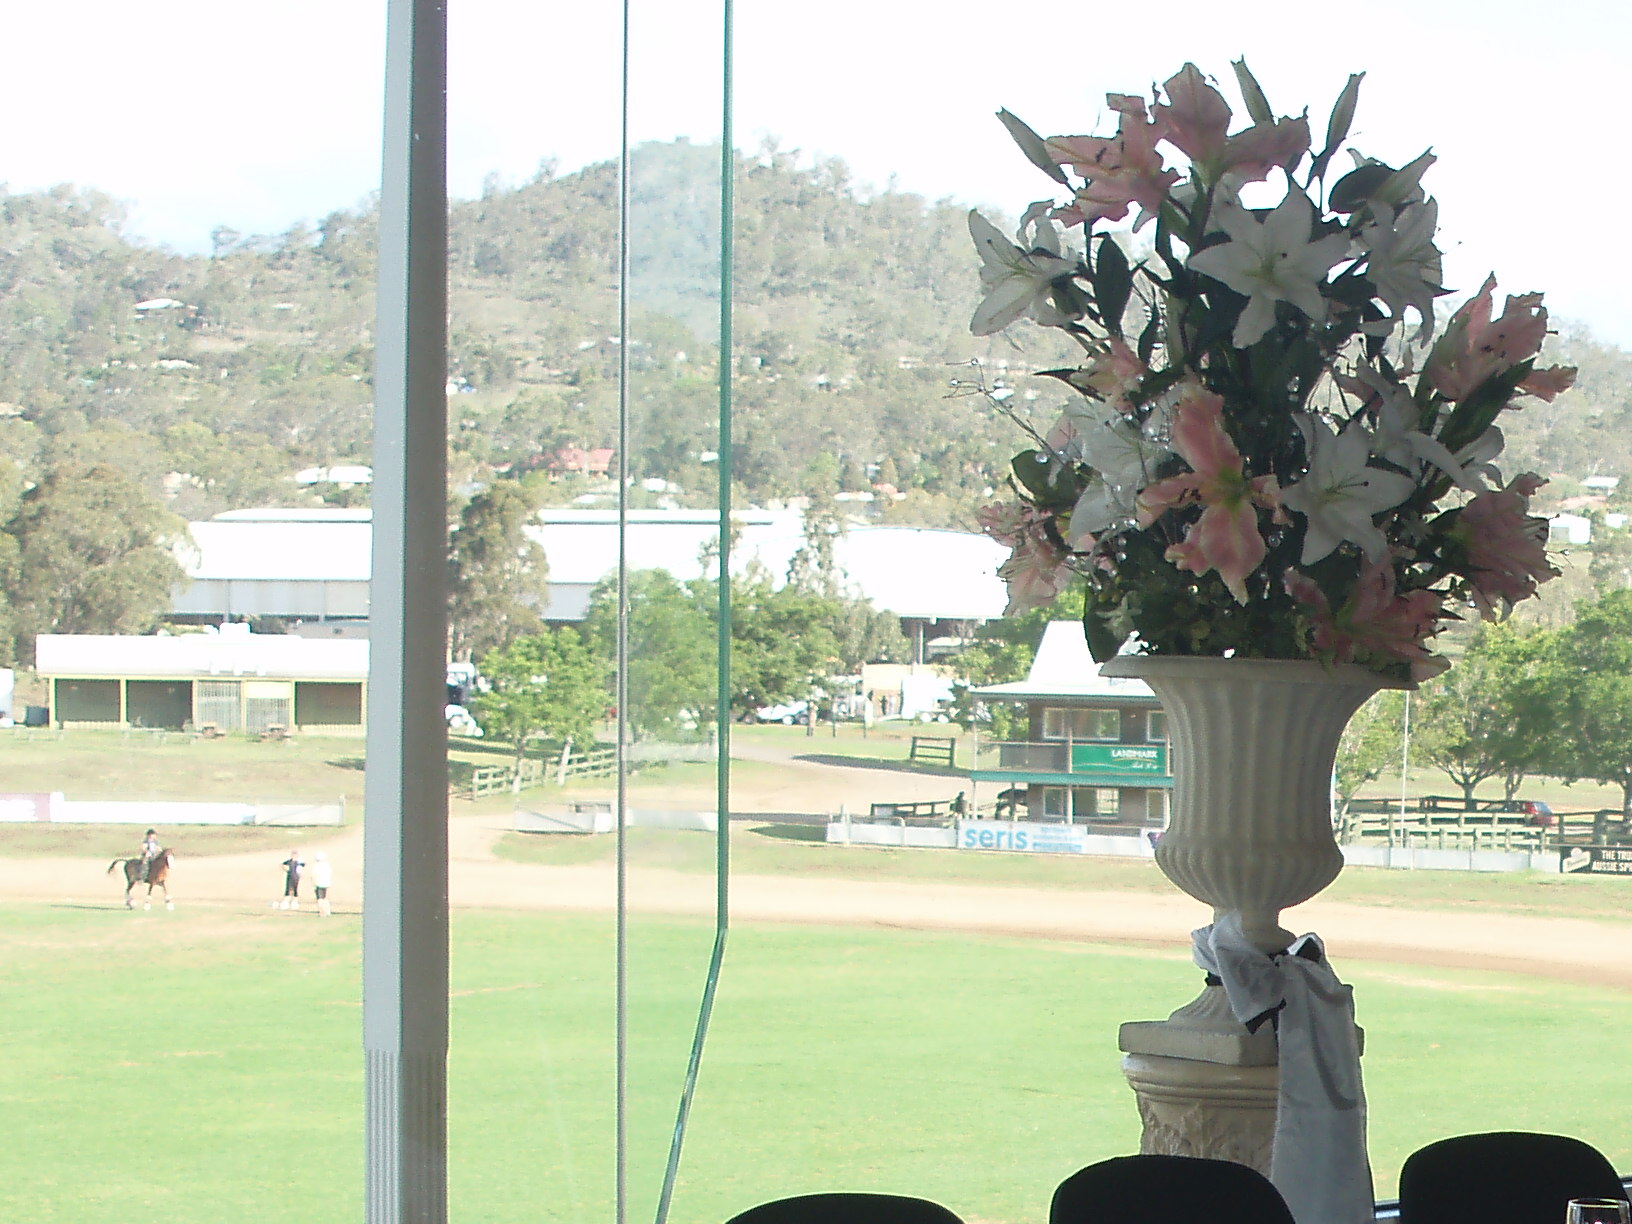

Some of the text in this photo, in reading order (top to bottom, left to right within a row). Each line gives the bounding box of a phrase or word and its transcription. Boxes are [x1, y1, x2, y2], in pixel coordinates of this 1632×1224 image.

[1111, 749, 1158, 758] LANDMARK
[1602, 850, 1616, 860] THE
[1592, 861, 1617, 871] AUSSIE
